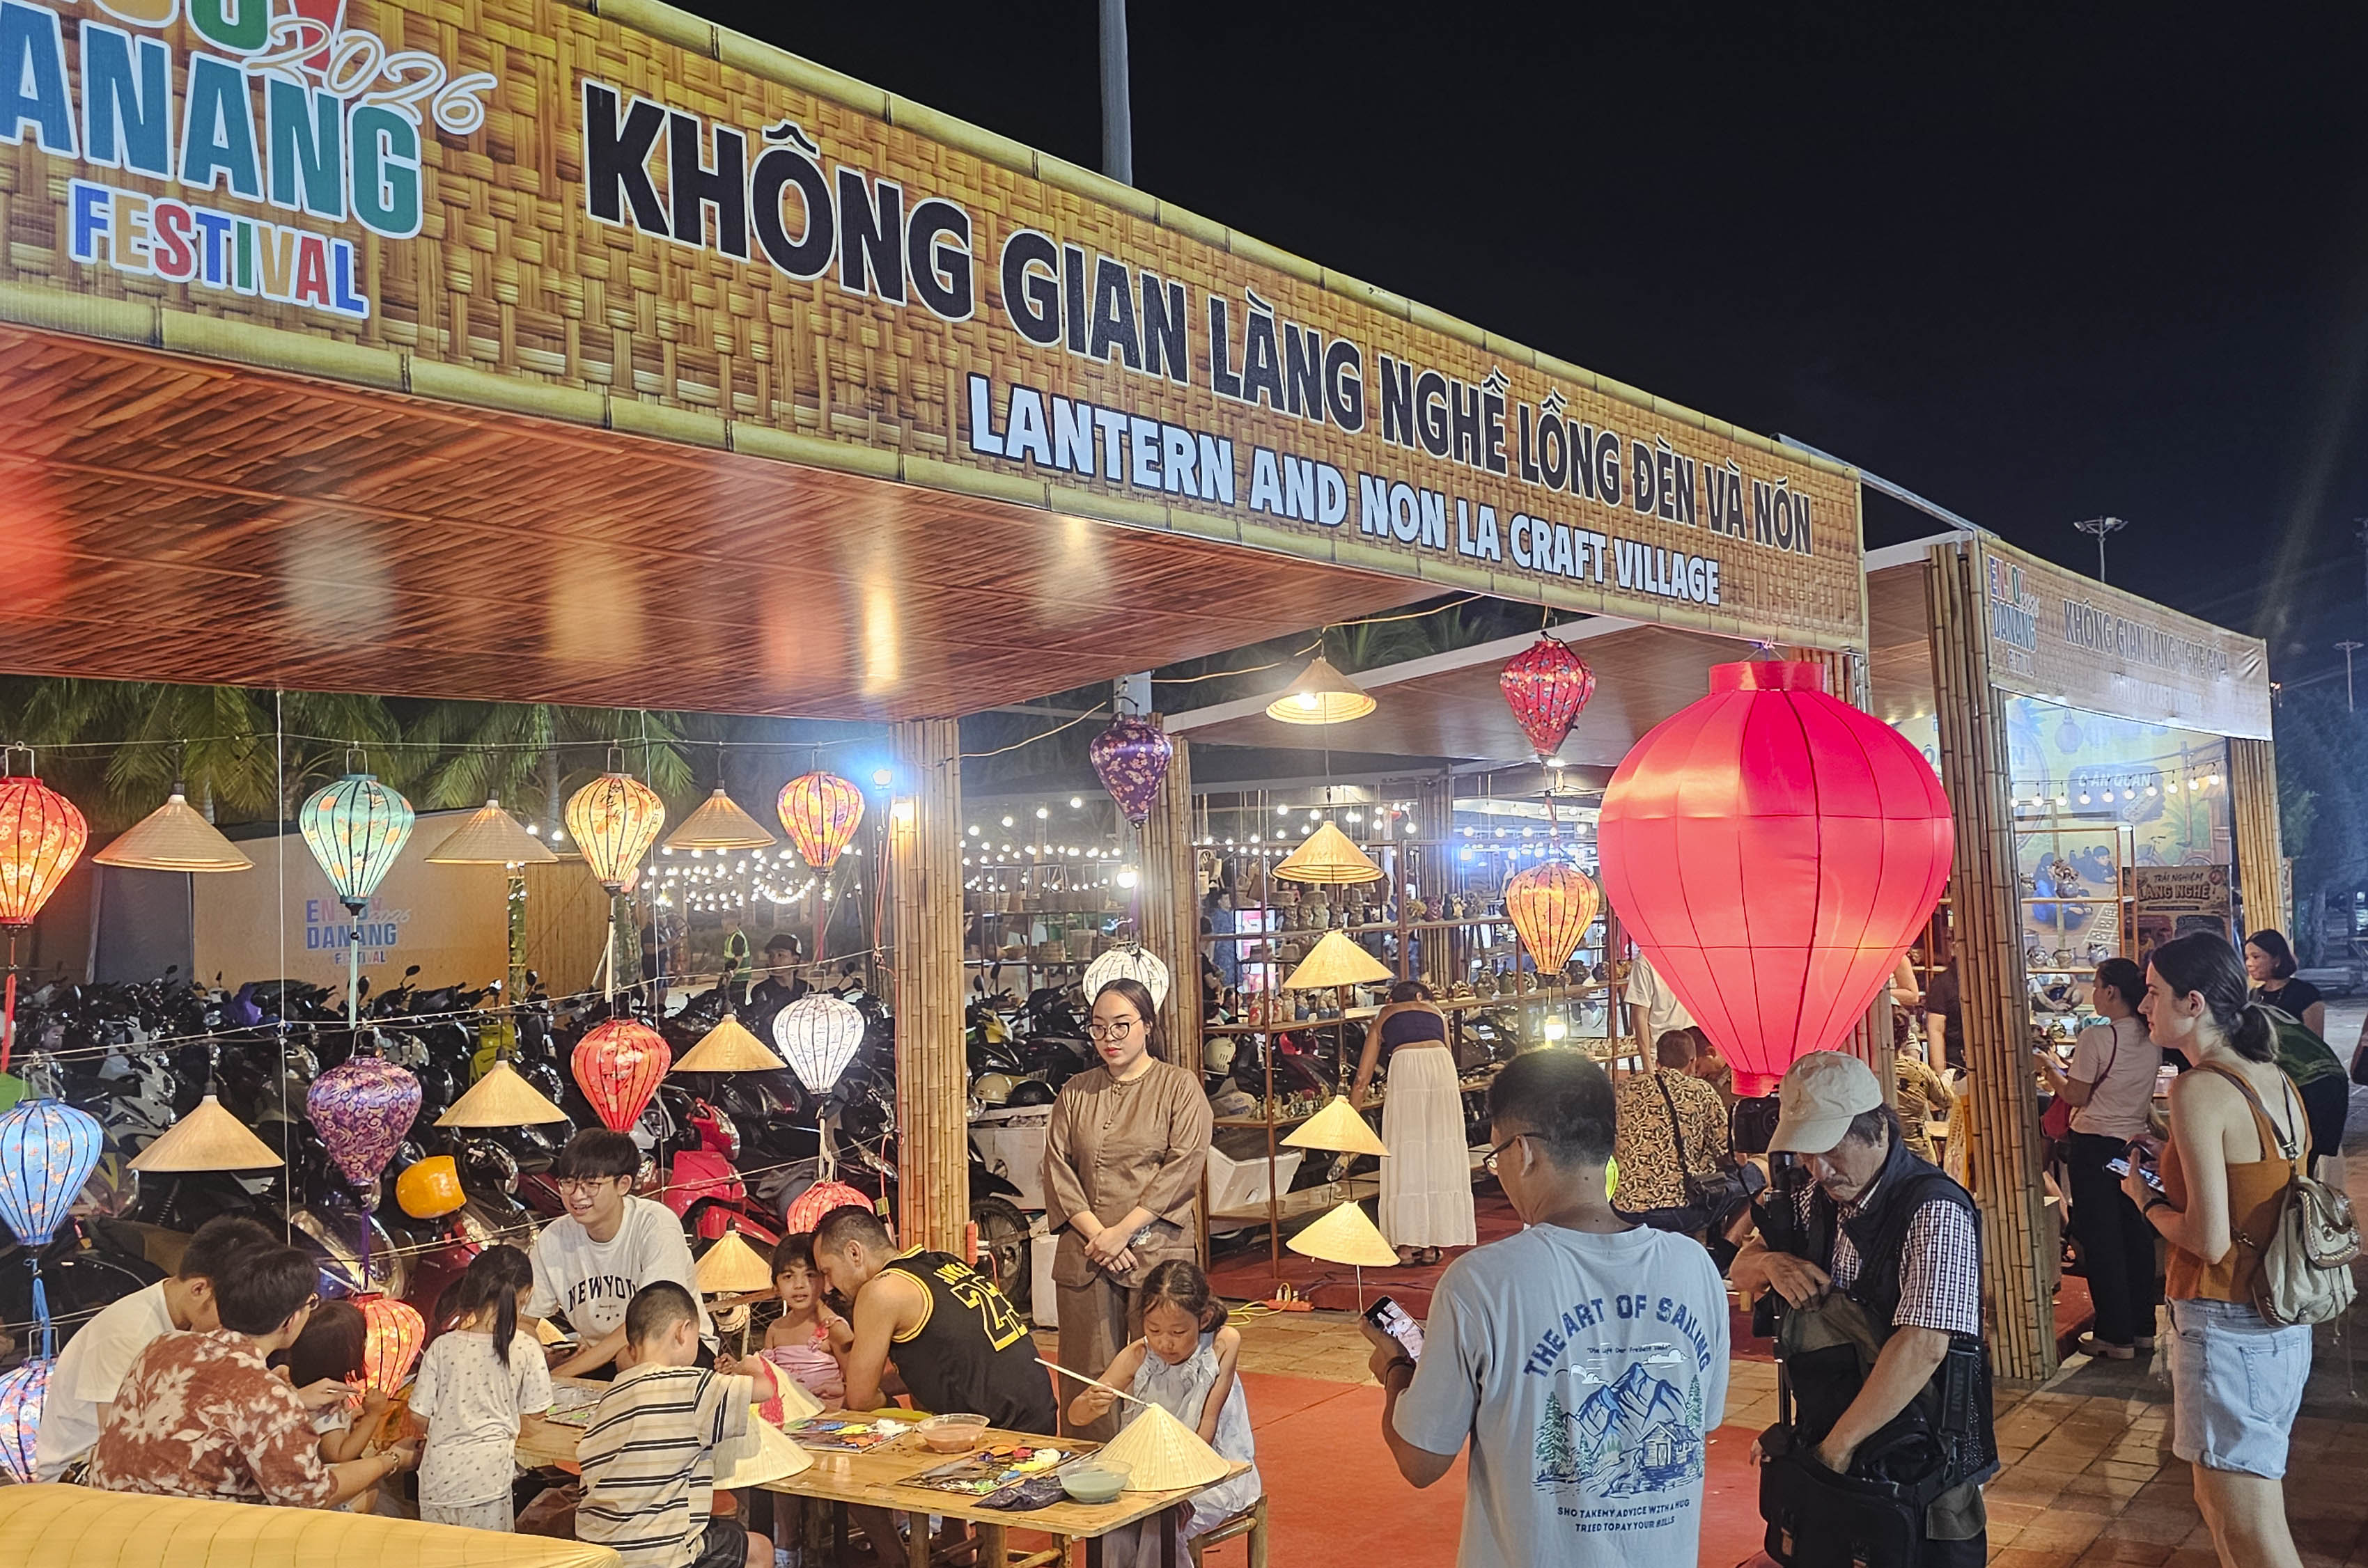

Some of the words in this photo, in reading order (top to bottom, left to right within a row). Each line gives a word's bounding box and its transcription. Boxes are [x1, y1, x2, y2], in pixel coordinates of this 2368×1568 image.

[244, 17, 497, 134] 2026
[70, 179, 369, 319] FESTIVAL
[581, 77, 975, 322] KHÔNG
[999, 228, 1189, 386] GIAN
[1208, 286, 1364, 434] LÀNG
[1378, 365, 1510, 478] NGHỀ
[1518, 386, 1621, 508] LỒNG
[1632, 433, 1697, 528] ĐÈN
[1703, 456, 1747, 541] VÀ
[1752, 476, 1812, 557] NÓN
[967, 372, 1235, 507] LANTERN
[1250, 446, 1348, 527] AND
[1359, 471, 1447, 551] NON
[1456, 497, 1502, 563] LA
[1509, 512, 1607, 583] CRAFT
[1613, 536, 1720, 606] VILLAGE
[2064, 597, 2112, 656] KHÔNG
[2115, 617, 2144, 662] GIAN
[306, 923, 397, 949] DANANG
[1523, 1328, 1567, 1377] THE
[1561, 1297, 1605, 1338] ART
[1616, 1295, 1646, 1319] OF
[1575, 1523, 1602, 1532] TRIED
[1616, 1506, 1646, 1518] ADVICE
[1648, 1504, 1669, 1514] WITH
